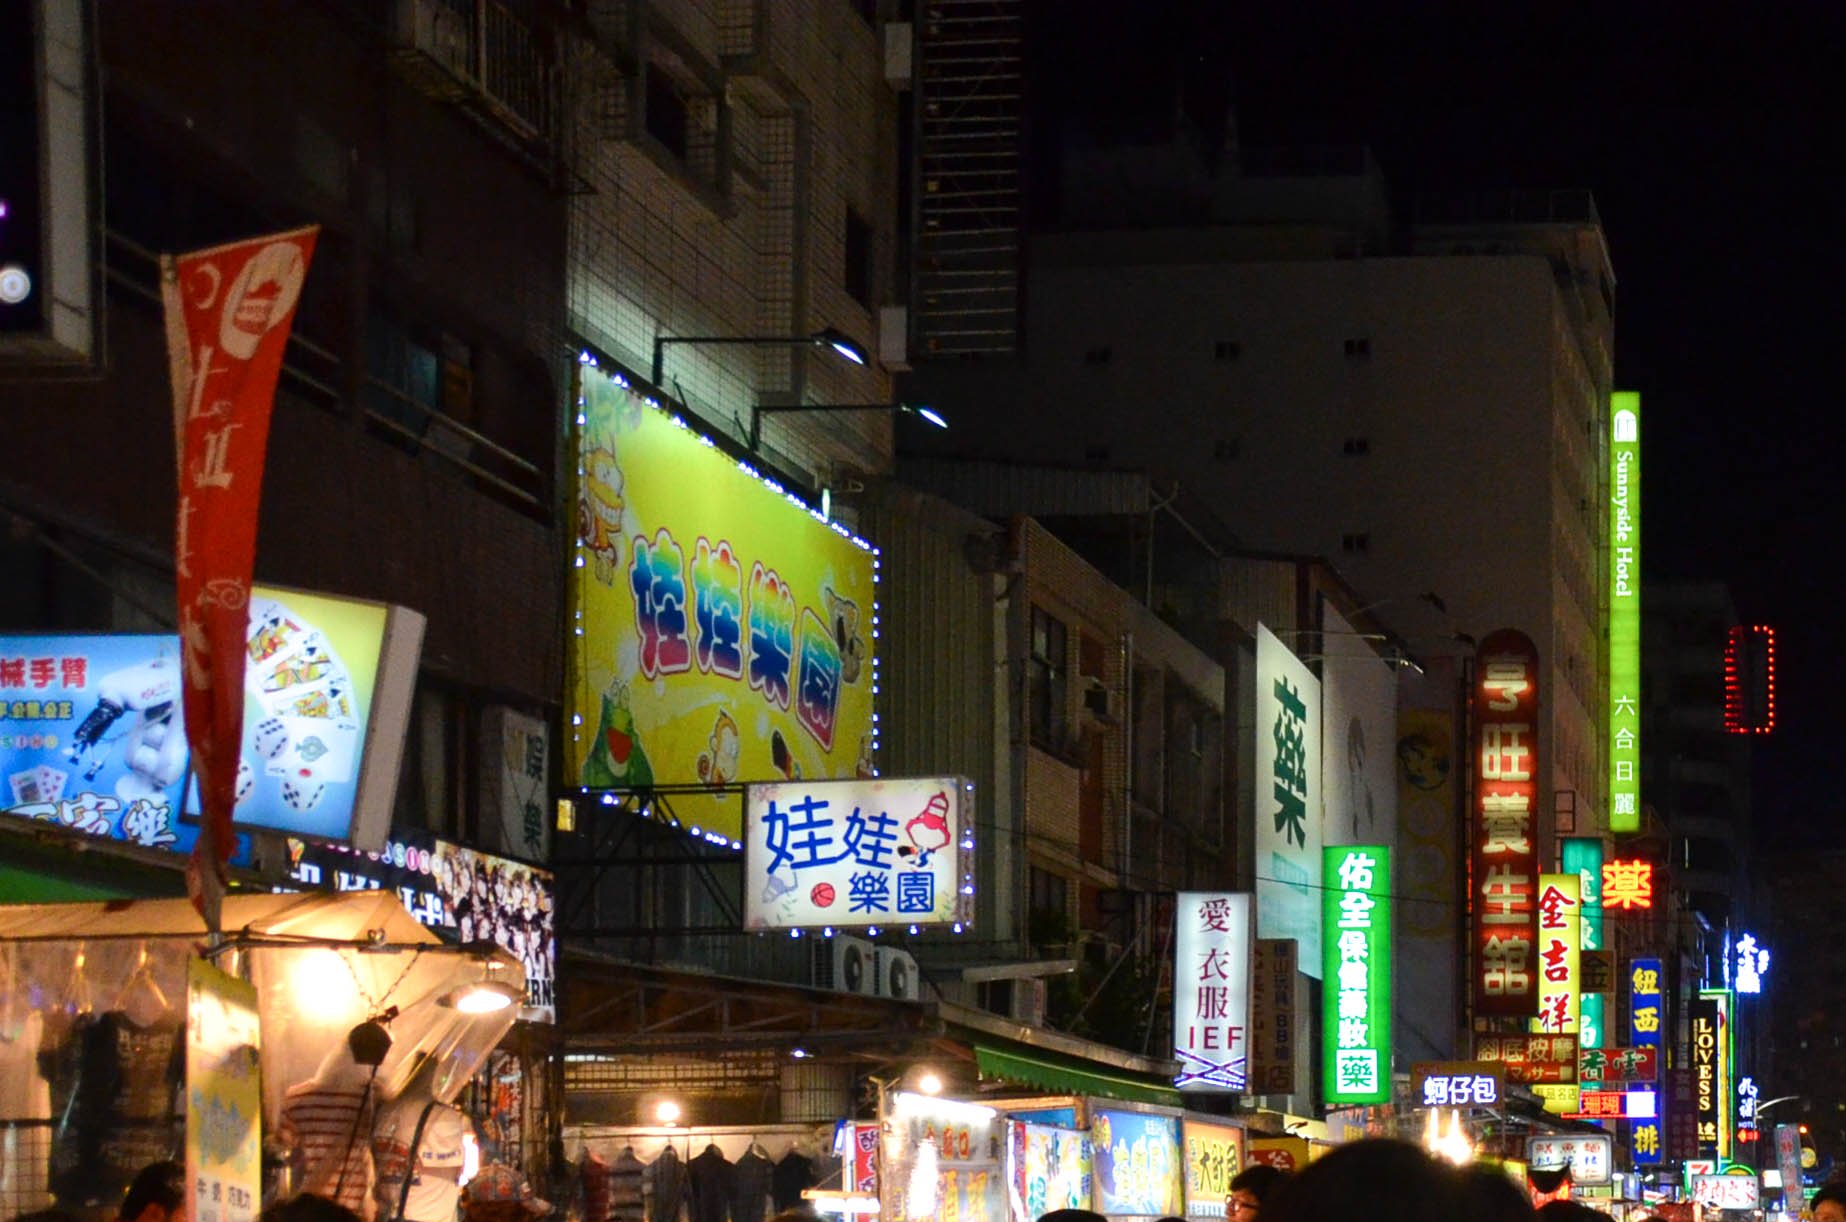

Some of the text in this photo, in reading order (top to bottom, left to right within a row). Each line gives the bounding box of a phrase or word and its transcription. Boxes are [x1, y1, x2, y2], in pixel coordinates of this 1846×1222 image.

[1613, 450, 1634, 597] Sunnyside Hotel
[630, 526, 843, 752] 娃娃樂園
[1273, 673, 1308, 851] 藥
[1613, 694, 1637, 816] 六合日麗
[762, 796, 899, 873] 娃娃
[1481, 654, 1532, 996] 亨旺養生館
[848, 871, 936, 914] 樂園
[1539, 885, 1576, 1034] 金吉祥
[1189, 1027, 1243, 1051] IEF
[1341, 1055, 1374, 1088] 藥
